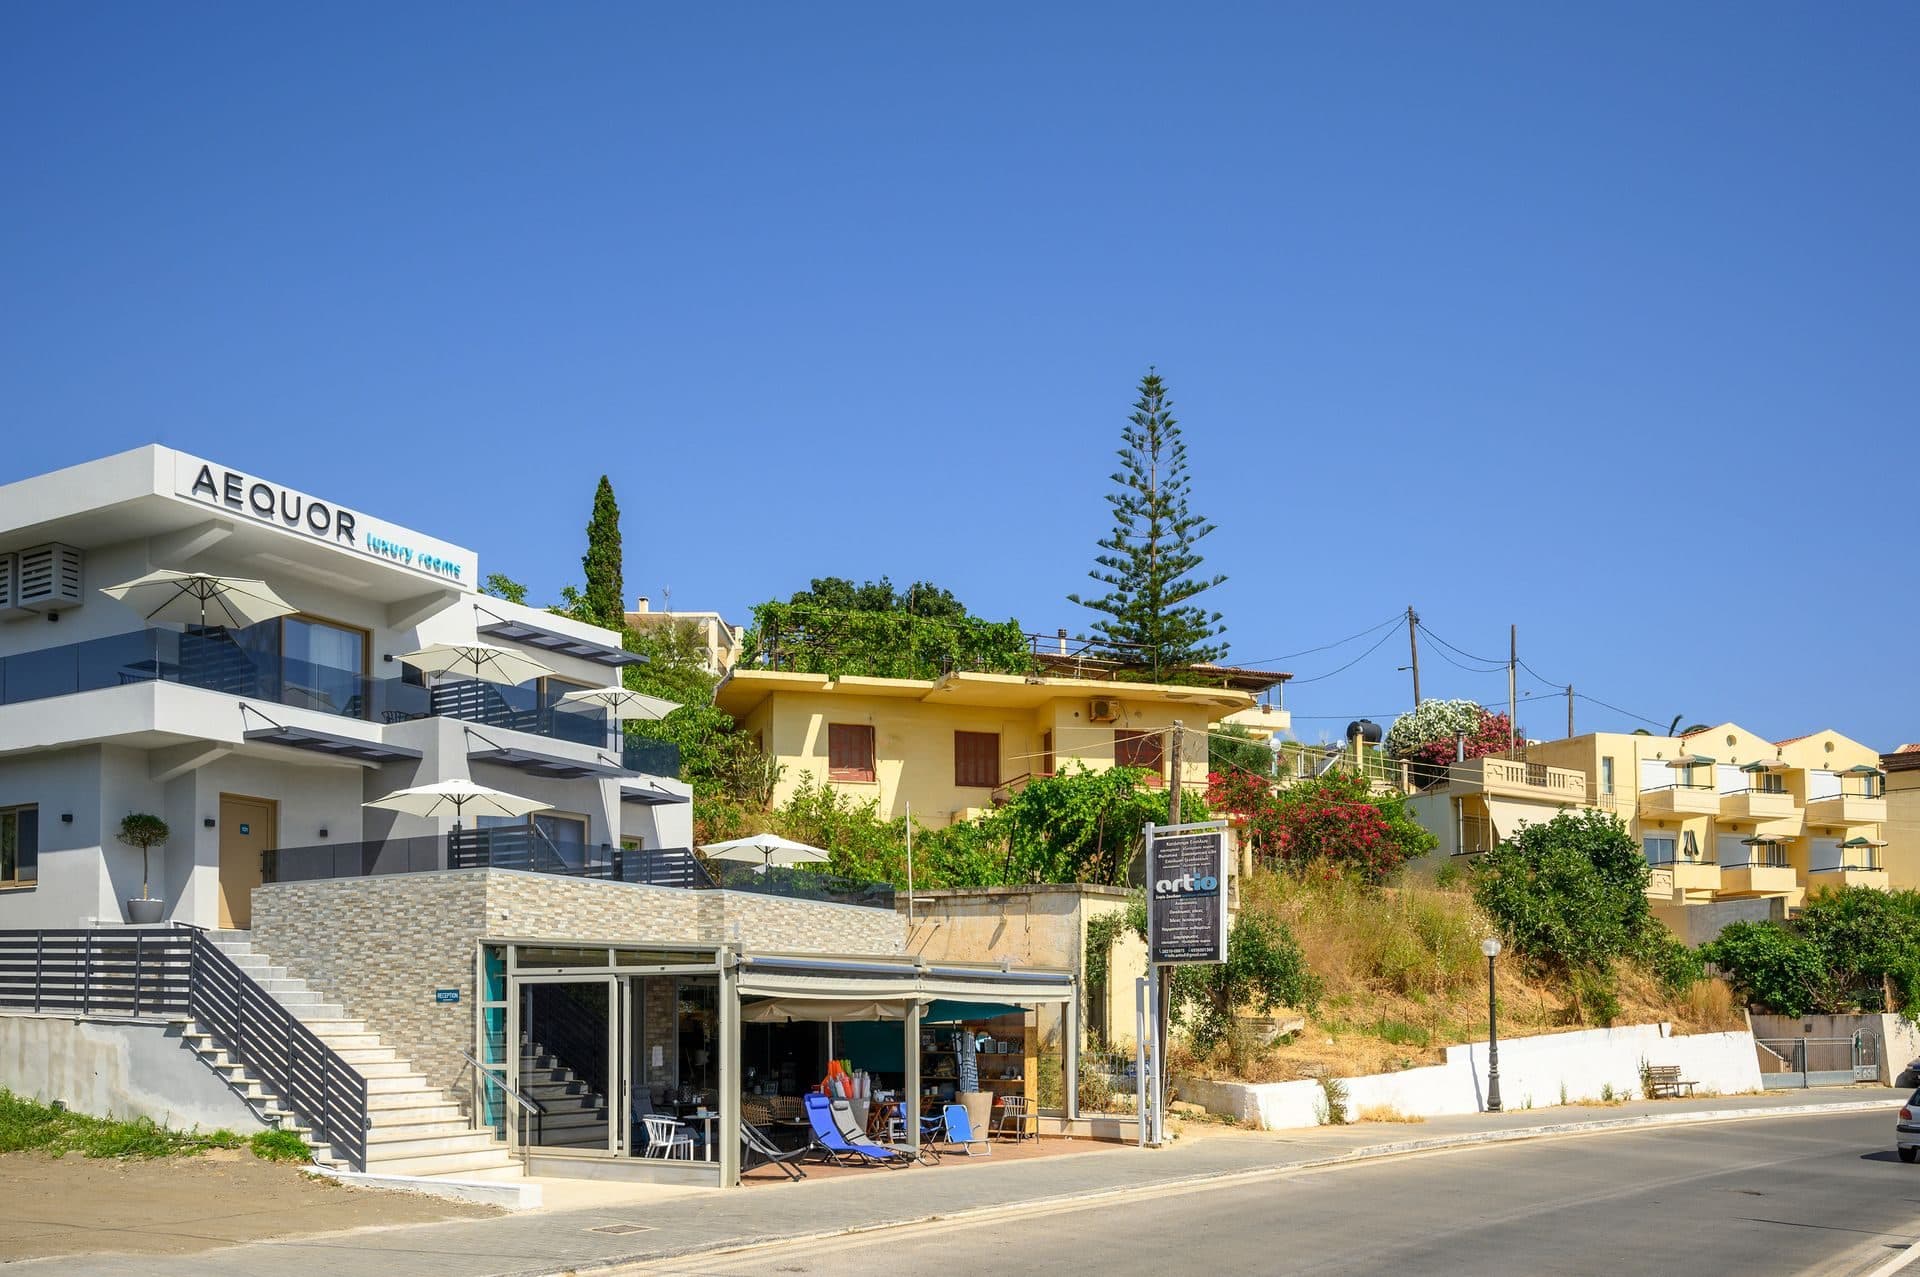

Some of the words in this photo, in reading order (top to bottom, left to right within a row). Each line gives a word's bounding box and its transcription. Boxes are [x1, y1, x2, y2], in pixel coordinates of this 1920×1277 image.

[192, 464, 356, 542] AEQUOR
[366, 532, 414, 562] luxury
[418, 553, 461, 577] rooms
[1156, 872, 1218, 893] artio
